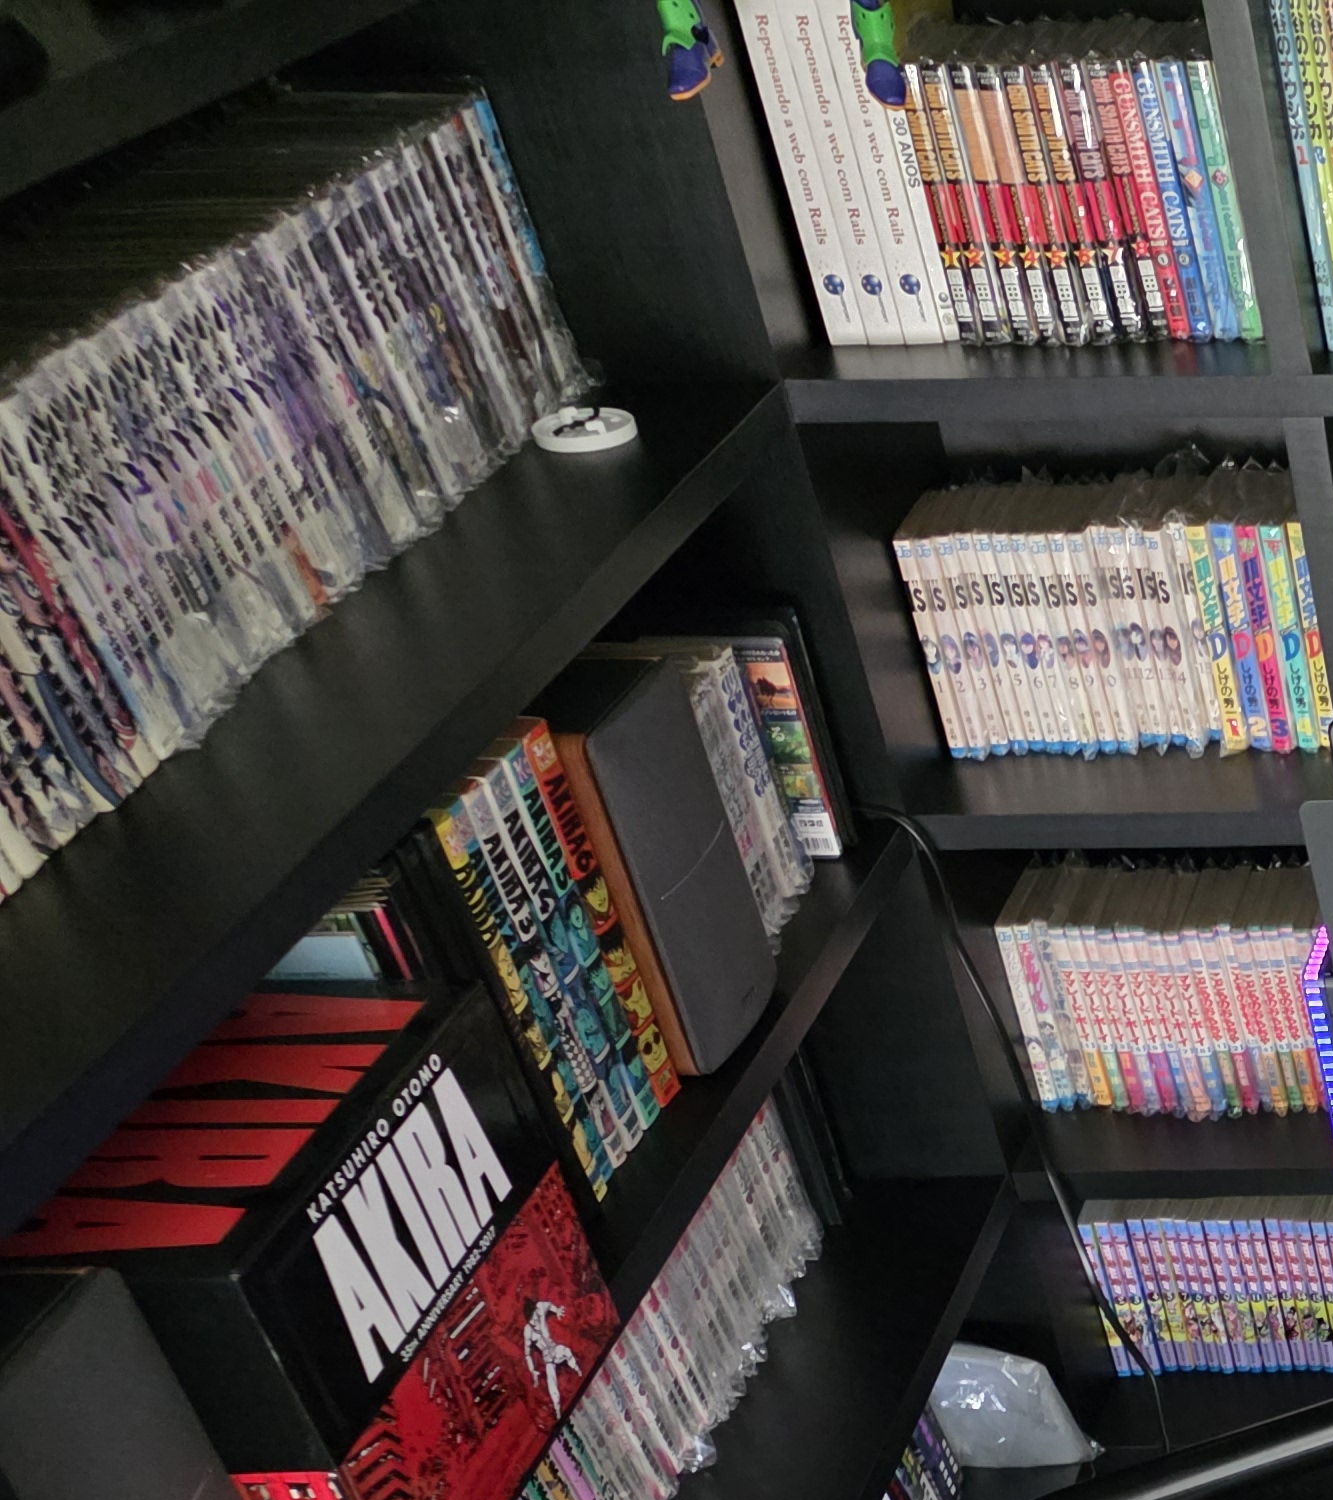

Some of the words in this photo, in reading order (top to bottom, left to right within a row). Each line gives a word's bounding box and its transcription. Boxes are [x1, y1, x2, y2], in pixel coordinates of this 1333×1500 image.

[755, 14, 790, 115] Repensando
[796, 14, 830, 115] Repensando
[784, 118, 793, 128] a
[824, 118, 833, 128] a
[836, 14, 871, 115] Repensando
[863, 118, 872, 128] a
[868, 132, 884, 164] web
[876, 167, 892, 202] com
[886, 207, 904, 245] Rails
[892, 116, 908, 137] 30
[788, 132, 806, 164] web
[828, 132, 844, 164] web
[898, 140, 921, 189] ANOS
[1113, 78, 1155, 183] GUNSMITH
[1140, 191, 1165, 238] CATS
[1136, 78, 1176, 183] GUNSMITH
[1162, 191, 1187, 238] CATS
[1297, 145, 1308, 165] 1
[798, 168, 814, 202] com
[837, 168, 852, 202] com
[808, 207, 827, 245] Rails
[847, 207, 866, 245] Rails
[1248, 716, 1267, 736] 2
[1271, 718, 1289, 737] 3
[544, 774, 588, 858] AKIRA
[575, 851, 594, 874] 6
[483, 832, 526, 917] AKIRA
[0, 993, 427, 1258] AKIRA
[306, 1118, 389, 1224] KATSUHIRO
[391, 1053, 442, 1117] OTOMO
[312, 1067, 513, 1384] AKIRA
[417, 1271, 464, 1341] ANNIVERSARY
[462, 1225, 497, 1275] 1982-2017
